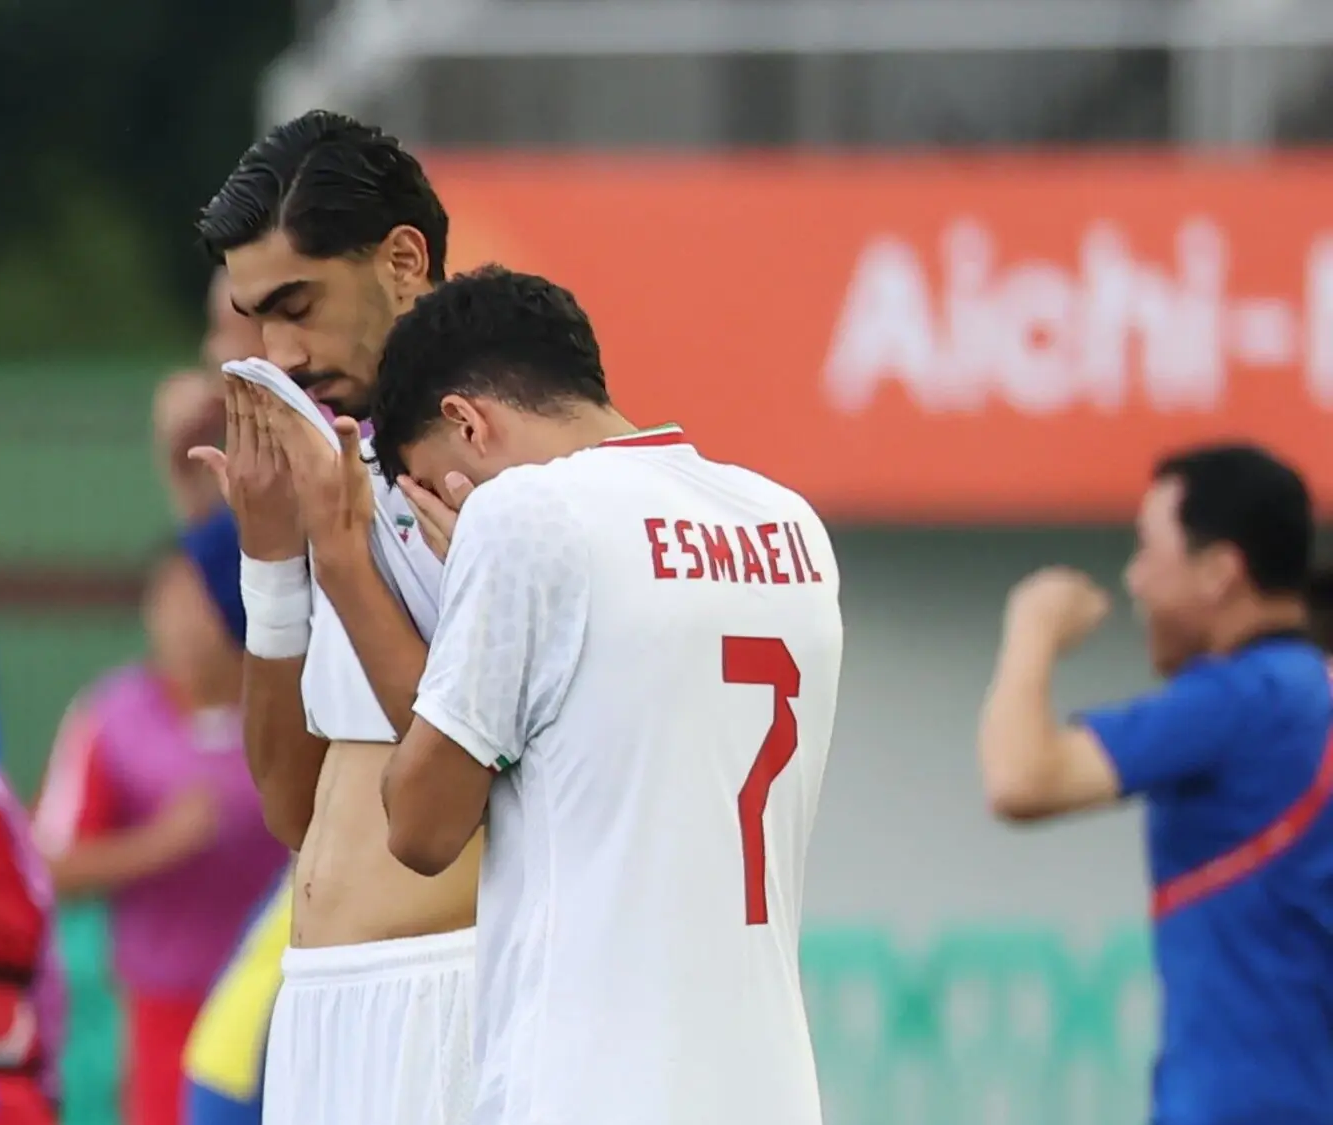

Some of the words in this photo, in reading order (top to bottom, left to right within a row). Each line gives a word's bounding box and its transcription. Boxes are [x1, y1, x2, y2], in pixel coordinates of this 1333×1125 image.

[820, 213, 1333, 413] Aichi-
[644, 517, 822, 585] ESMAEIL
[722, 635, 801, 925] 7
